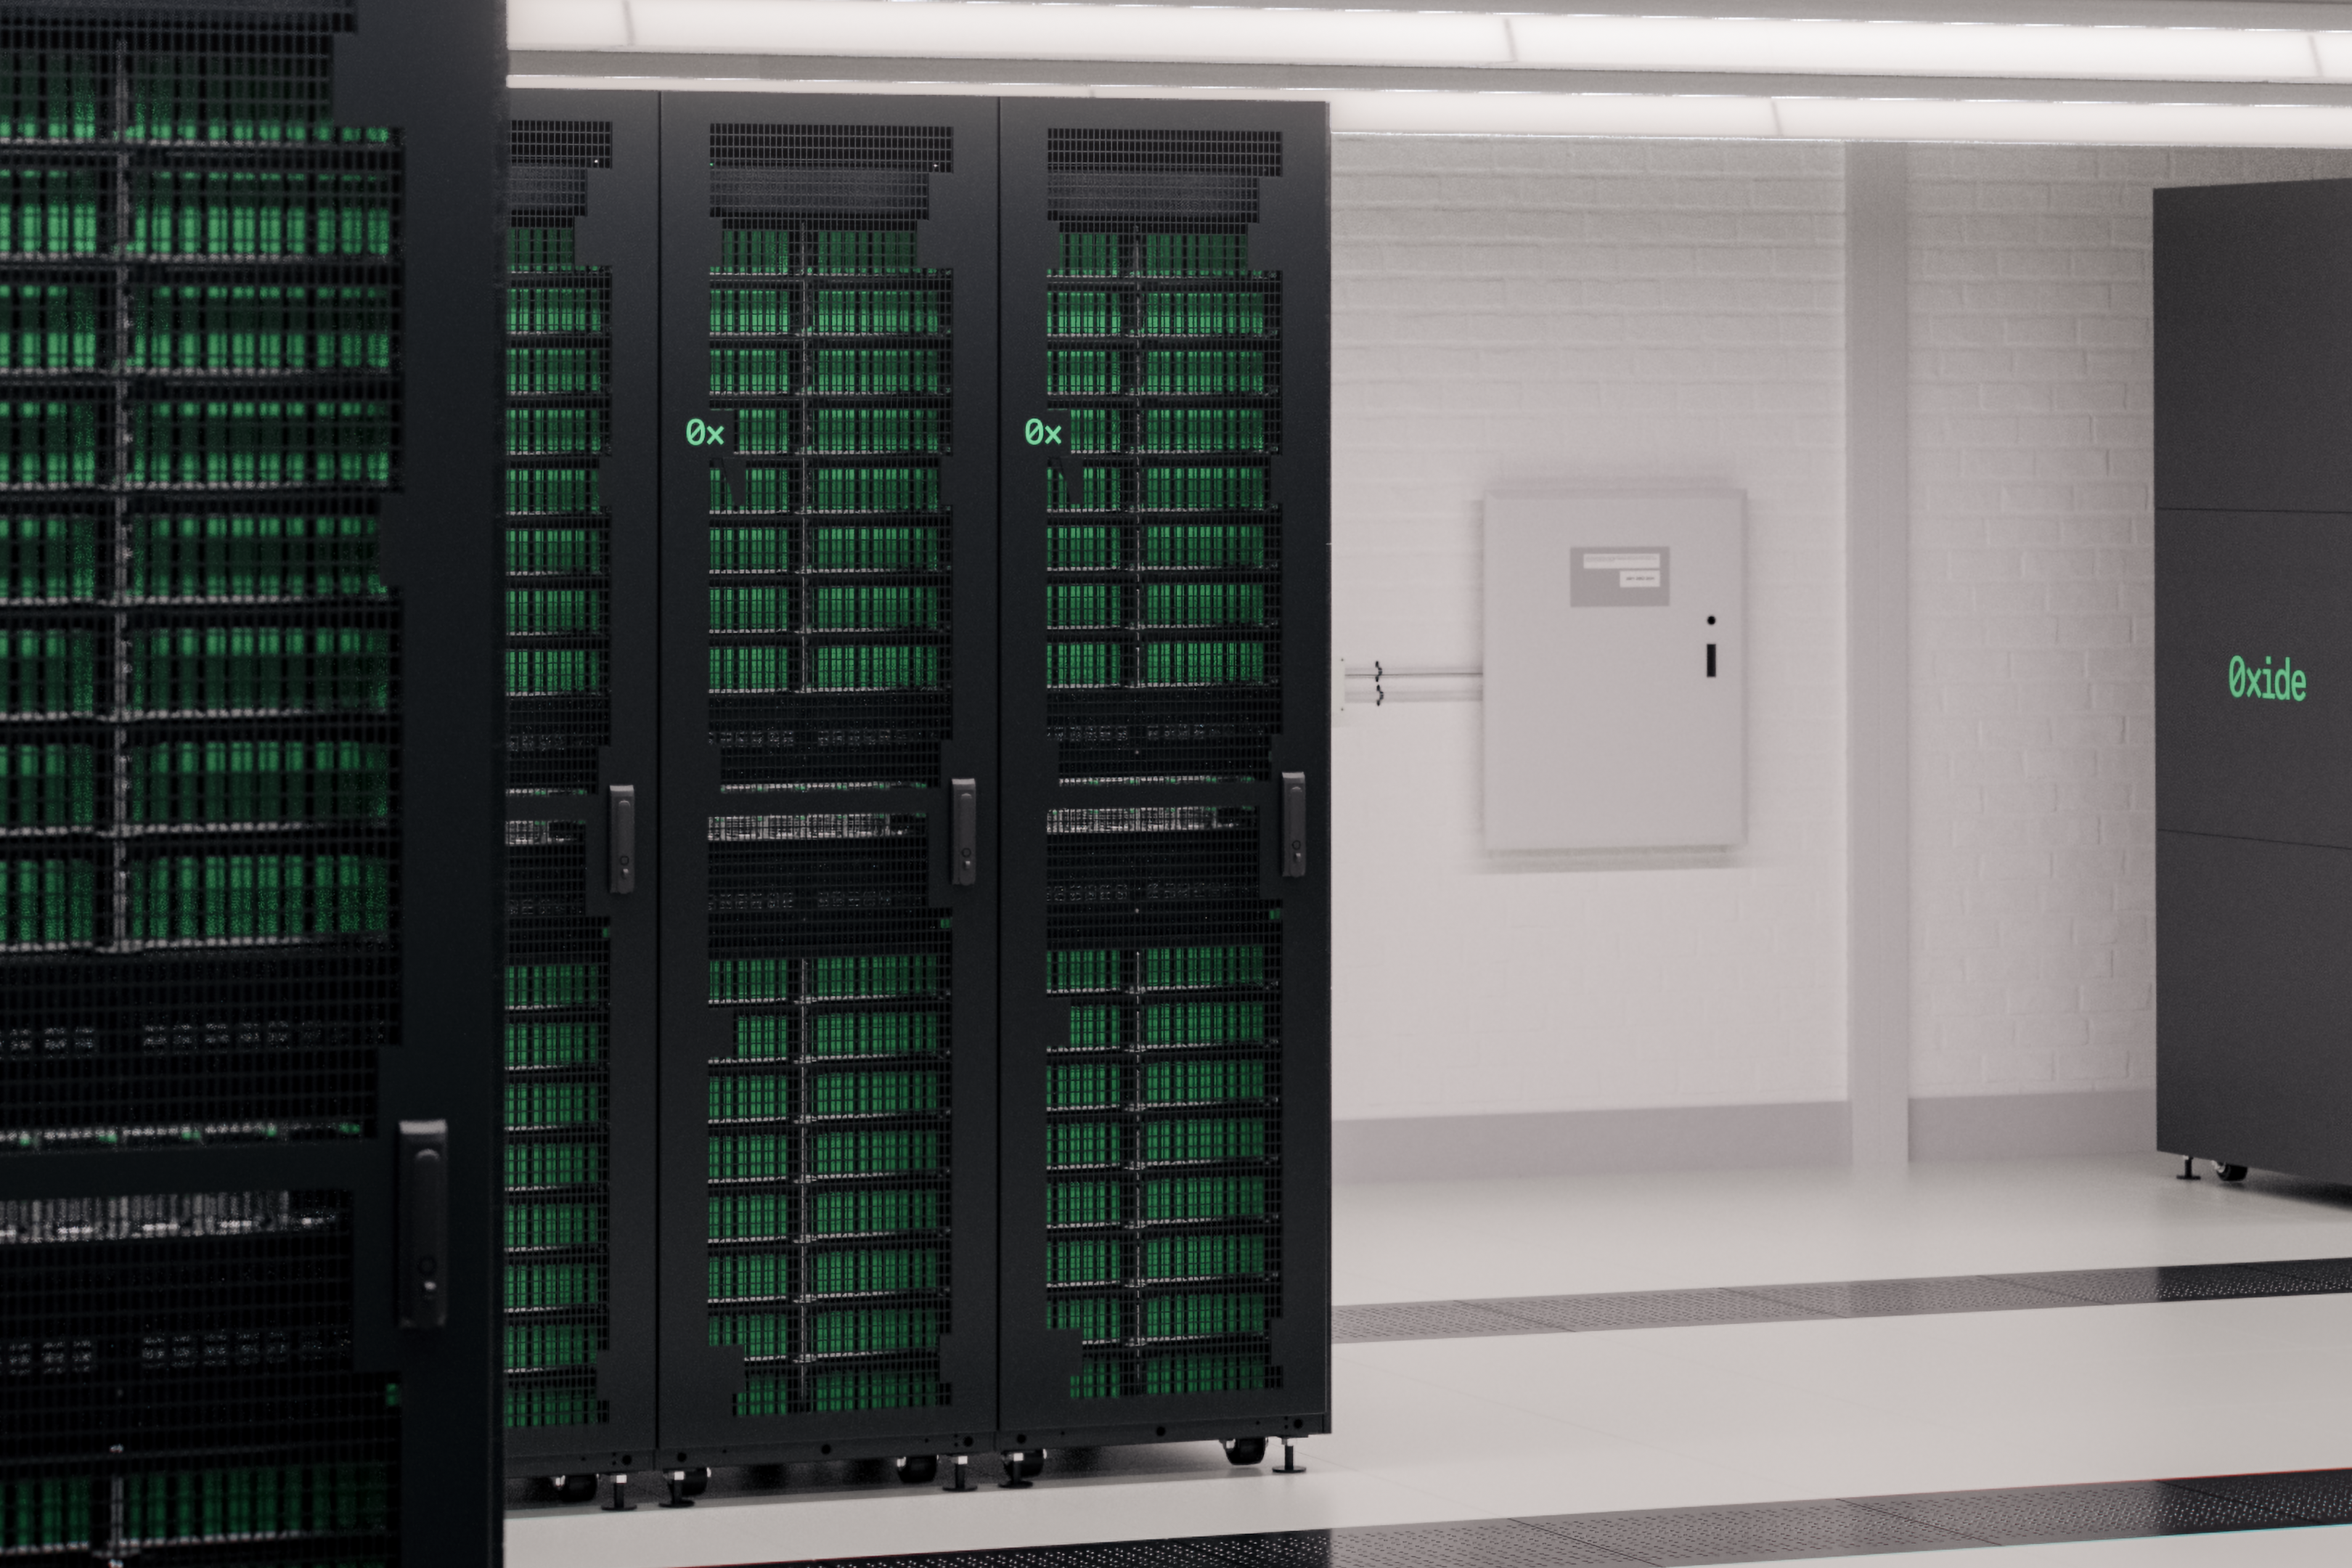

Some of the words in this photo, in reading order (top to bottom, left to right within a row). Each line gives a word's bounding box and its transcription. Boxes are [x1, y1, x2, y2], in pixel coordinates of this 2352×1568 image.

[685, 418, 724, 446] 0x
[1024, 418, 1061, 445] 0x
[2229, 655, 2307, 702] 0xide
